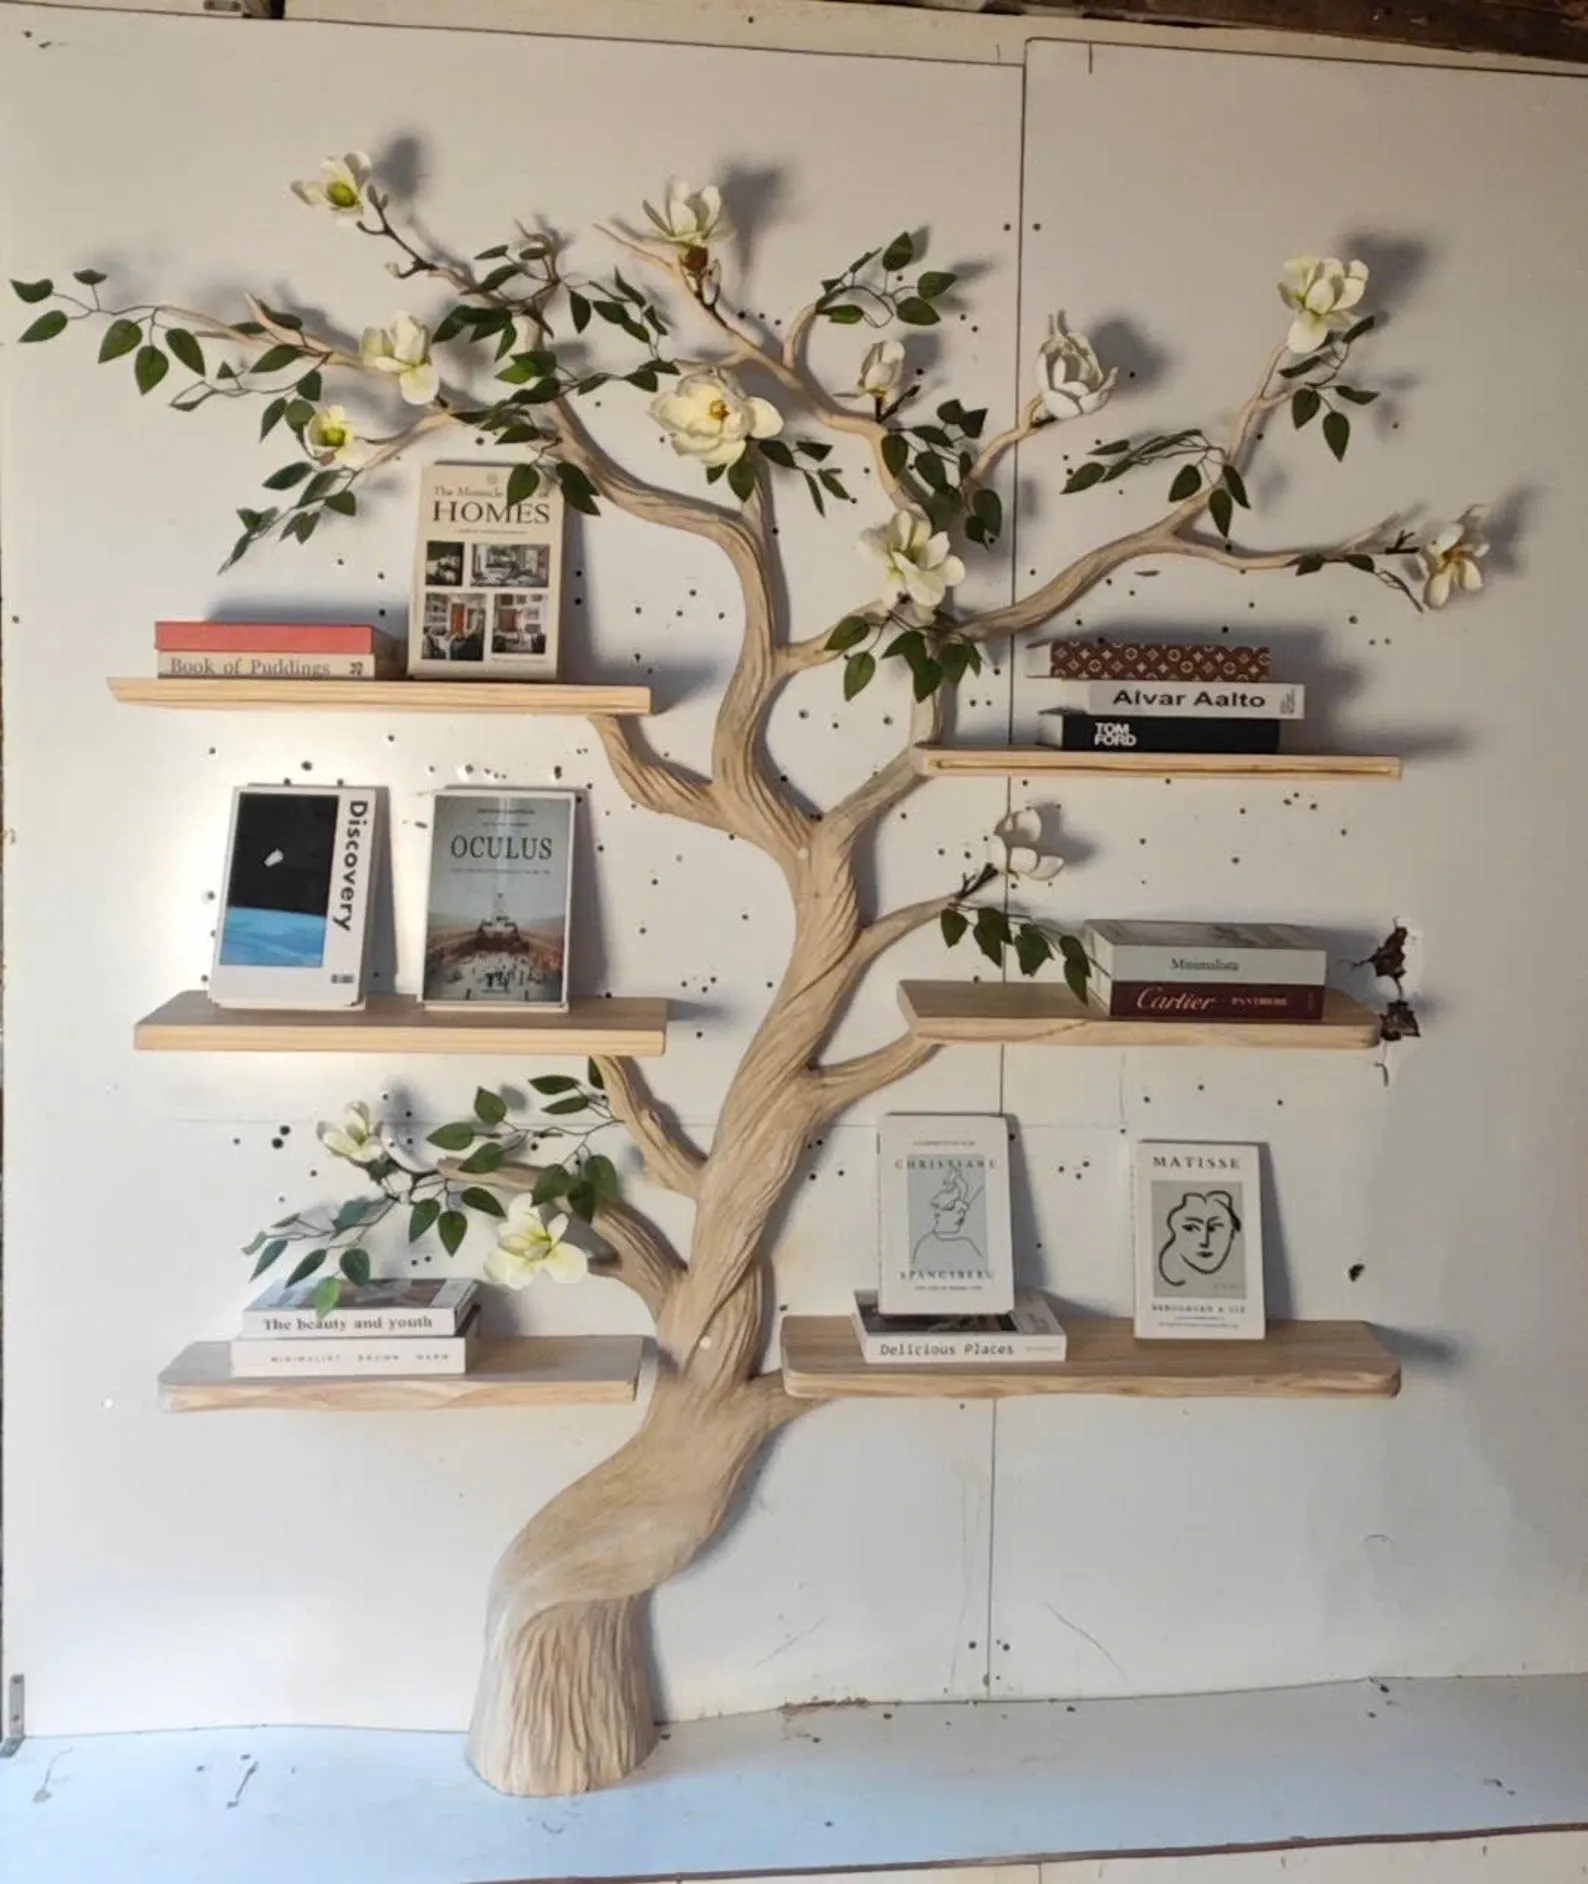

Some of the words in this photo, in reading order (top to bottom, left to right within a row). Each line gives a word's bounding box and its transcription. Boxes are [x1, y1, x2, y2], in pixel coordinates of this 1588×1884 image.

[433, 500, 550, 524] HOMES
[170, 658, 215, 674] Book
[223, 658, 241, 677] of
[251, 659, 330, 677] Puddings
[1113, 689, 1186, 707] Alvar
[1194, 690, 1265, 708] Aalto
[1094, 722, 1130, 736] TOM
[1094, 733, 1137, 747] FORD
[450, 835, 552, 860] OCULUS
[333, 800, 368, 932] Discovery
[1137, 986, 1215, 1010] Cartier
[1152, 1156, 1240, 1169] MATISSE
[264, 1318, 291, 1331] The
[297, 1317, 348, 1331] beauty
[354, 1316, 382, 1329] and
[388, 1315, 432, 1330] youth
[880, 1343, 956, 1356] Delicious
[964, 1343, 1014, 1355] Places
